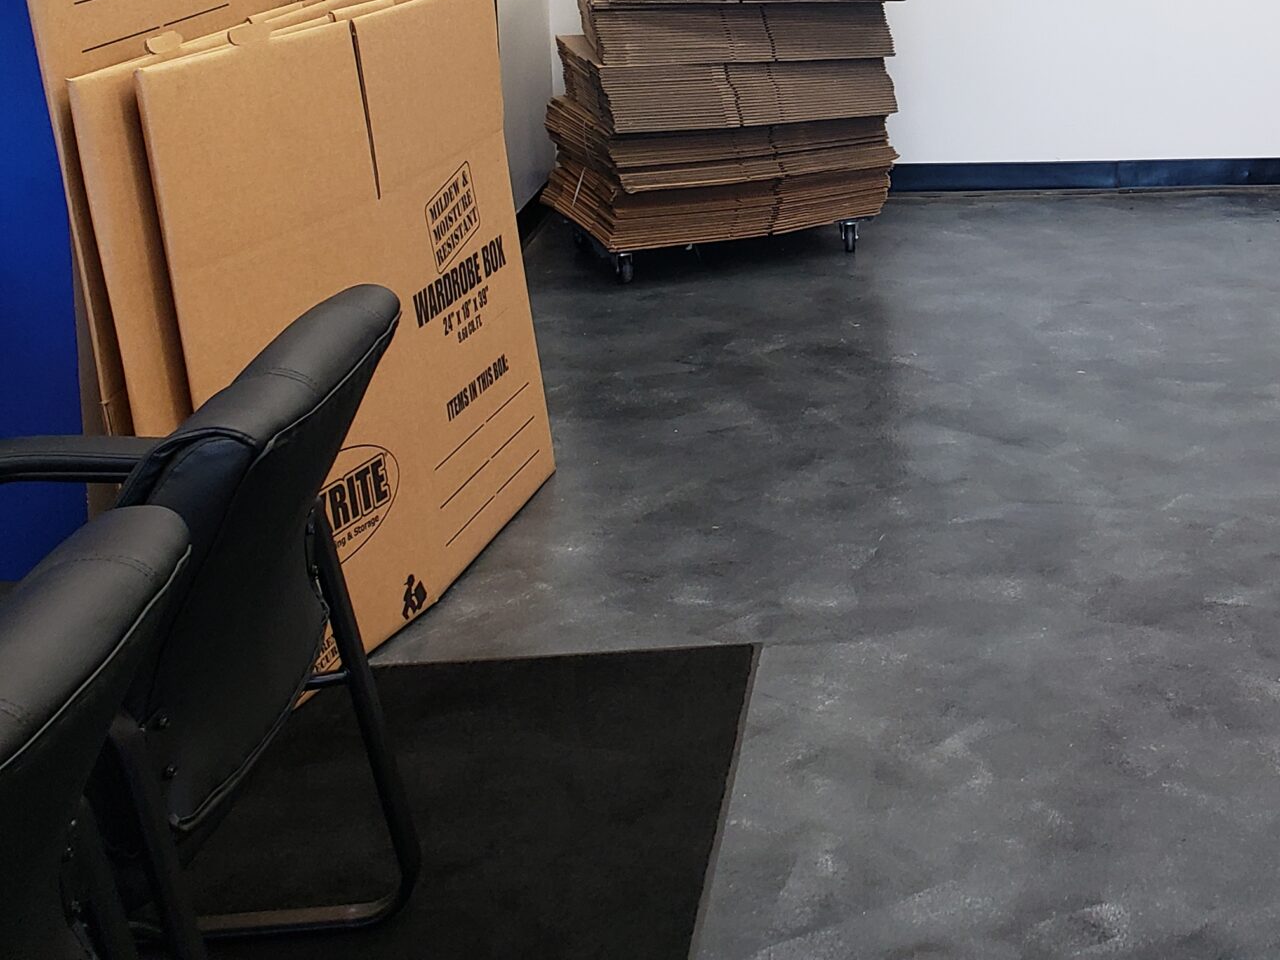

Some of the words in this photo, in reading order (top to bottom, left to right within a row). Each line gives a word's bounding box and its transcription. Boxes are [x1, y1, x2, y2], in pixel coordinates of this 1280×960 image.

[429, 177, 460, 225] MILDEW
[462, 170, 469, 188] &
[433, 189, 473, 245] MOISTURE
[436, 206, 478, 266] RESISTANT
[413, 251, 482, 329] WARDROBE
[481, 234, 506, 278] BOX
[446, 387, 469, 422] ITEMS
[468, 380, 478, 403] IN
[476, 366, 494, 395] THIS
[492, 353, 509, 381] BOX:
[322, 456, 391, 533] RITE
[353, 515, 380, 537] Storage
